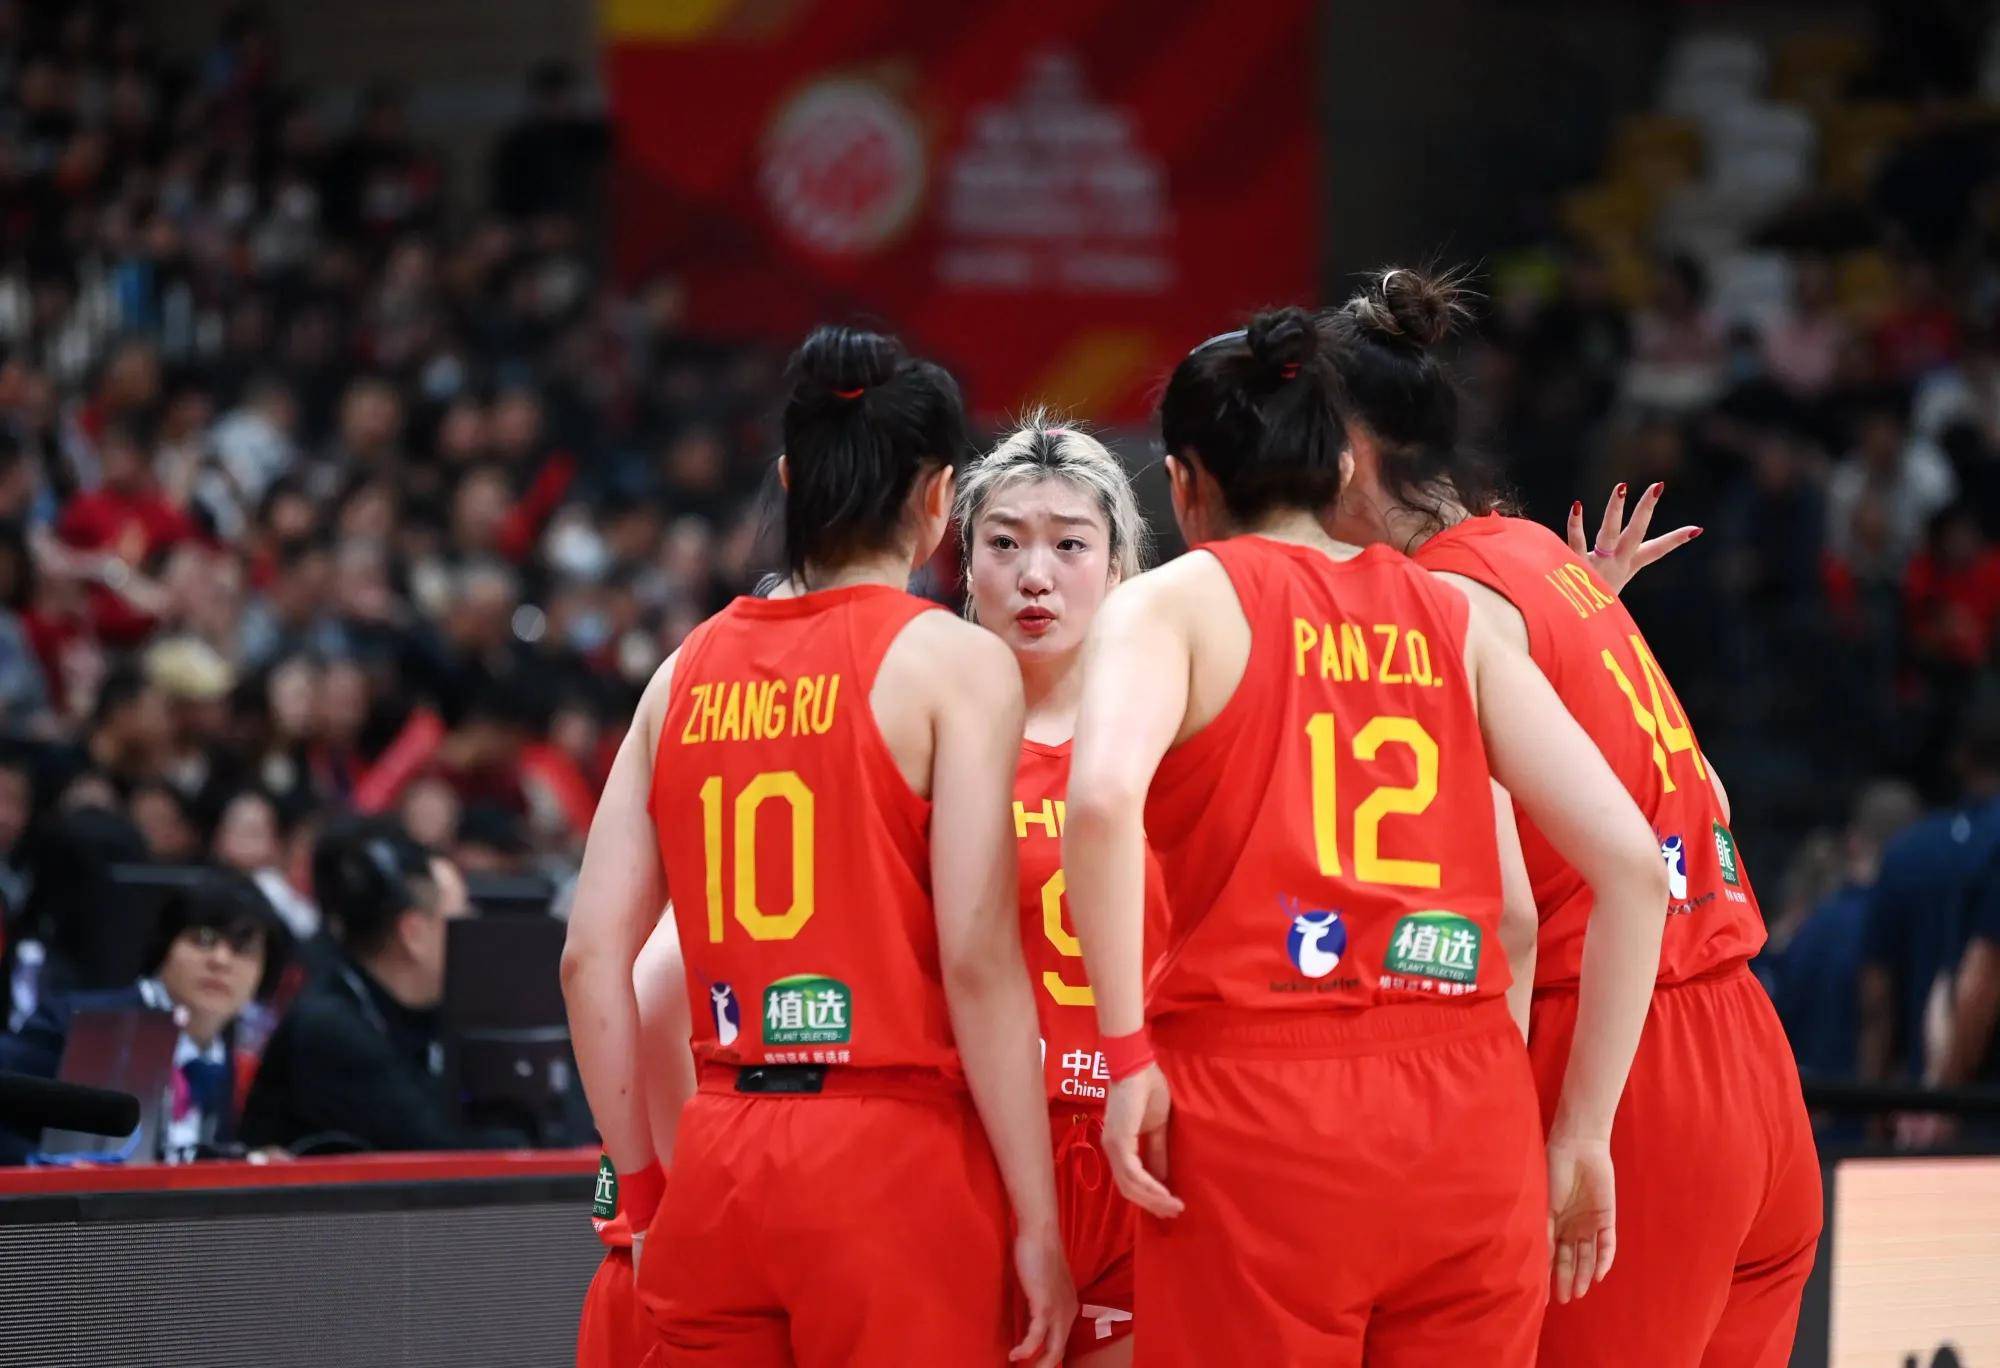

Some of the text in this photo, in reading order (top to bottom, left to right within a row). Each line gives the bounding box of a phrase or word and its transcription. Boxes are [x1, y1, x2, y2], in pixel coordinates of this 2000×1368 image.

[1294, 617, 1369, 682] PAN
[681, 673, 841, 745] ZHANG RU
[1601, 634, 1706, 793] 14
[1305, 712, 1441, 889] 12
[699, 770, 815, 943] 10
[1395, 922, 1477, 970] 植选
[766, 988, 847, 1030] 植选
[773, 1030, 838, 1042] PLANT SELECTED
[1061, 1078, 1106, 1099] China
